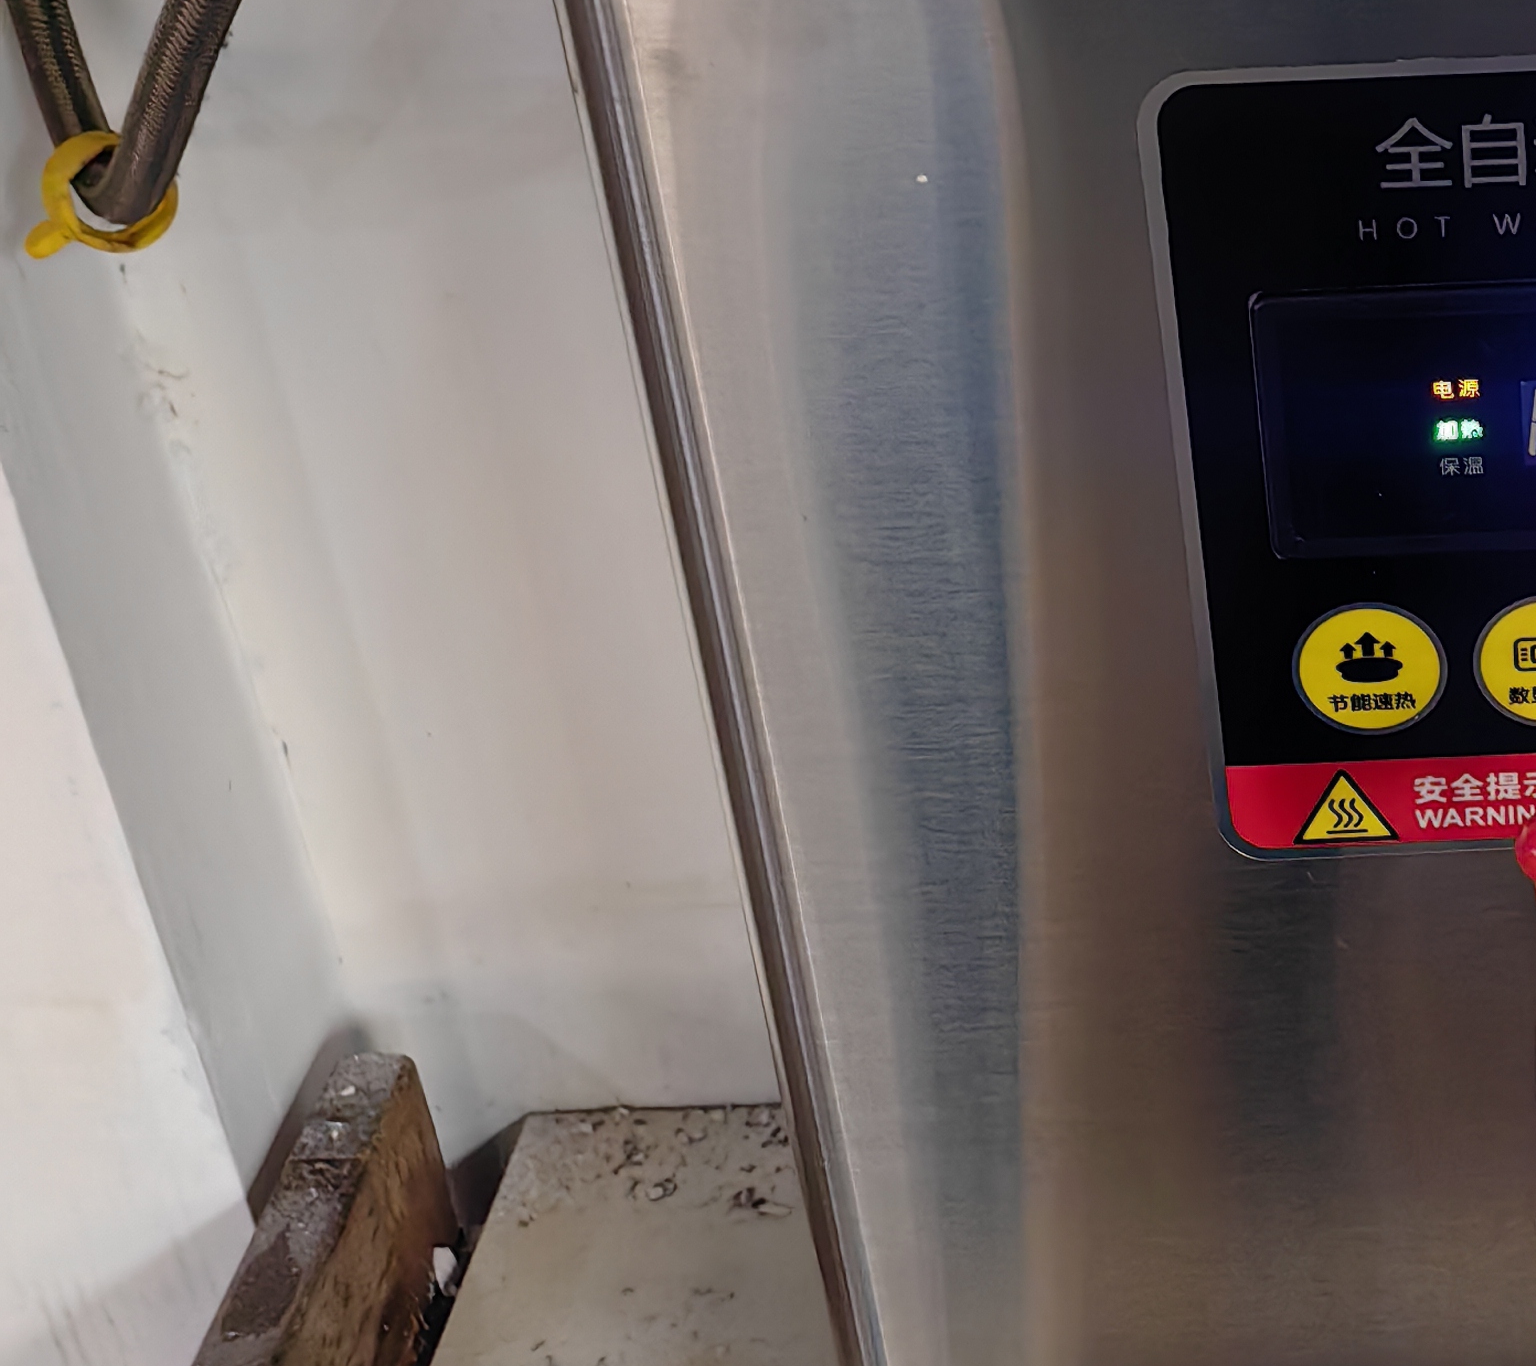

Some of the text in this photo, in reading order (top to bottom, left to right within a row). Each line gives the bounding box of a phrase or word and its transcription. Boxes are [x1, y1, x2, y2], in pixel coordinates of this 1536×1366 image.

[1358, 216, 1451, 241] HOT
[1432, 379, 1481, 399] 电源
[1329, 691, 1416, 712] 节能速热
